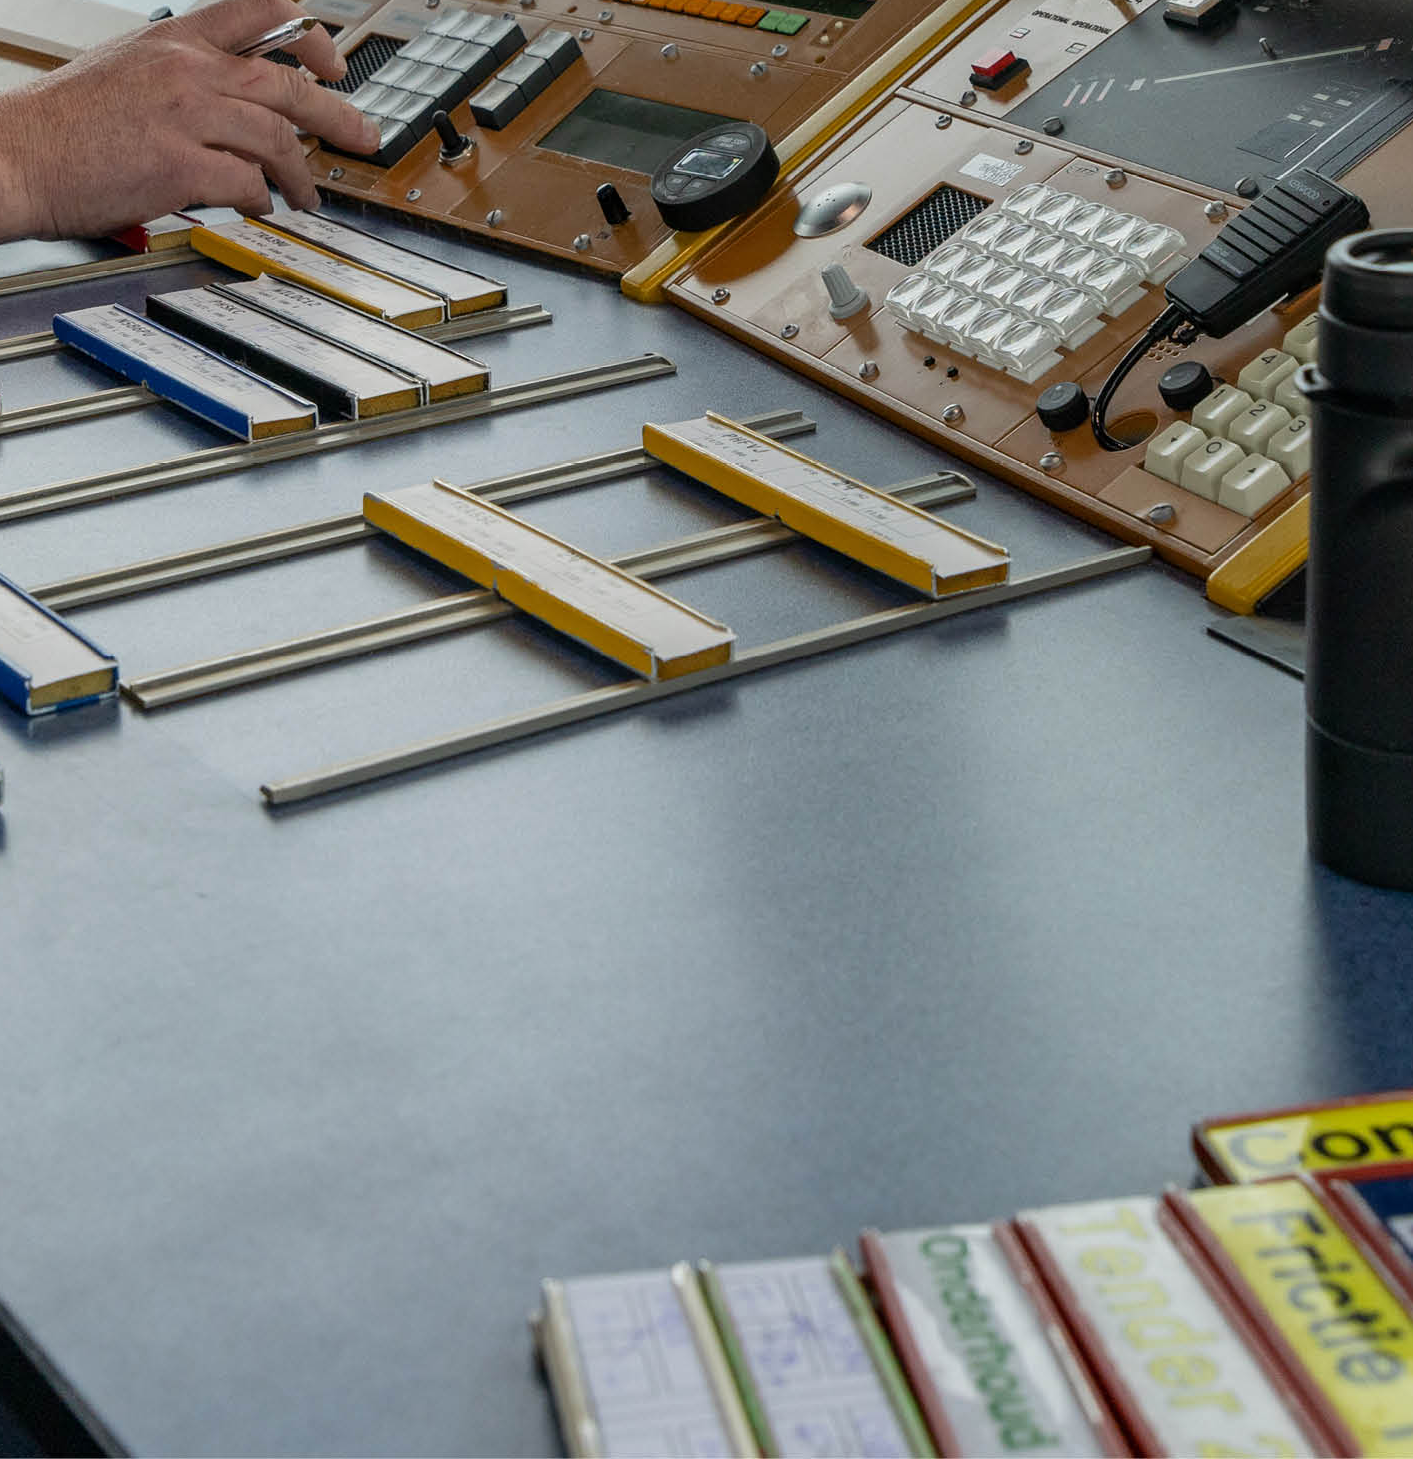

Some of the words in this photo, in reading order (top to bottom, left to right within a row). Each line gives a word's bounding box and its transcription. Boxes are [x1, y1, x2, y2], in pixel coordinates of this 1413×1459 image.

[1031, 9, 1072, 25] OPERATIONAL
[1072, 19, 1113, 35] OPERATIONAL
[1261, 355, 1277, 365] 4
[1213, 388, 1226, 399] 1
[1249, 404, 1267, 417] 2
[1288, 420, 1307, 433] 3
[1206, 441, 1223, 454] 0
[1057, 1207, 1247, 1414] Tender
[1230, 1208, 1405, 1385] Frictie
[920, 1234, 1060, 1452] Onderhoud
